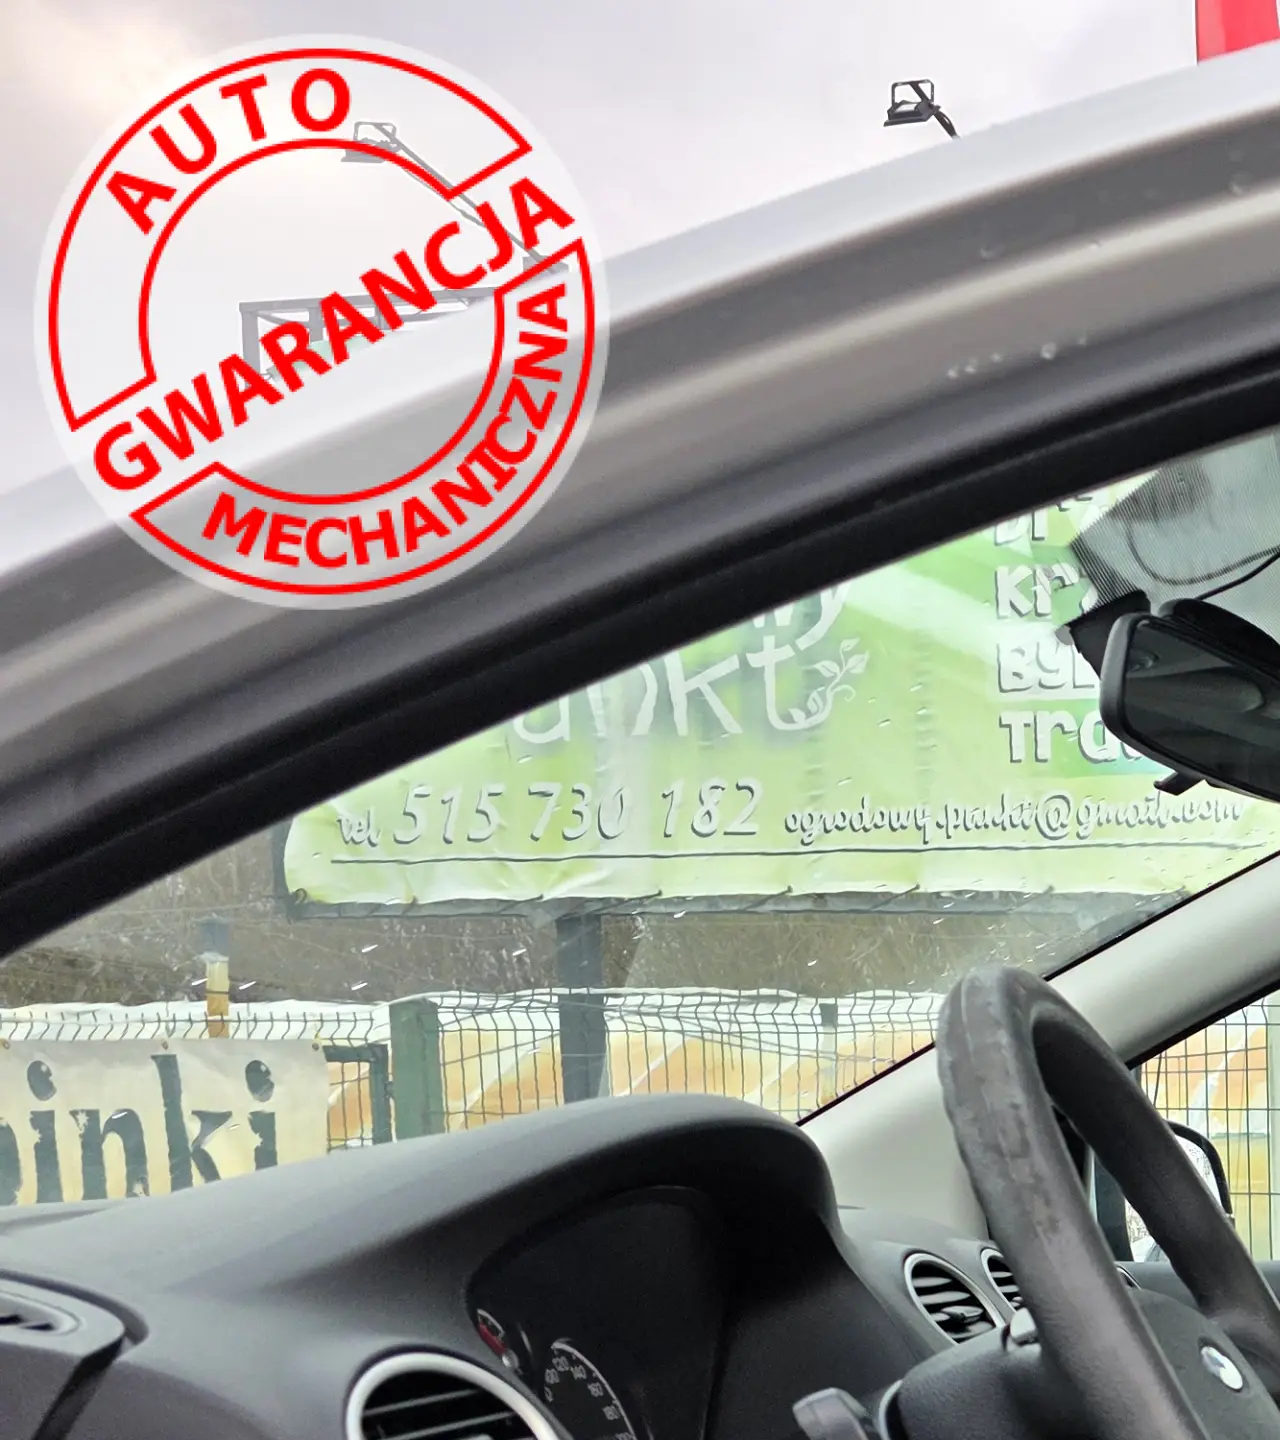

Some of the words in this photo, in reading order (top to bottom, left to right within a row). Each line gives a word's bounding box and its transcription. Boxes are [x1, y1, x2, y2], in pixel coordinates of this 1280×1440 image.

[393, 783, 506, 846] 515
[527, 779, 634, 843] 730
[660, 775, 765, 839] 182
